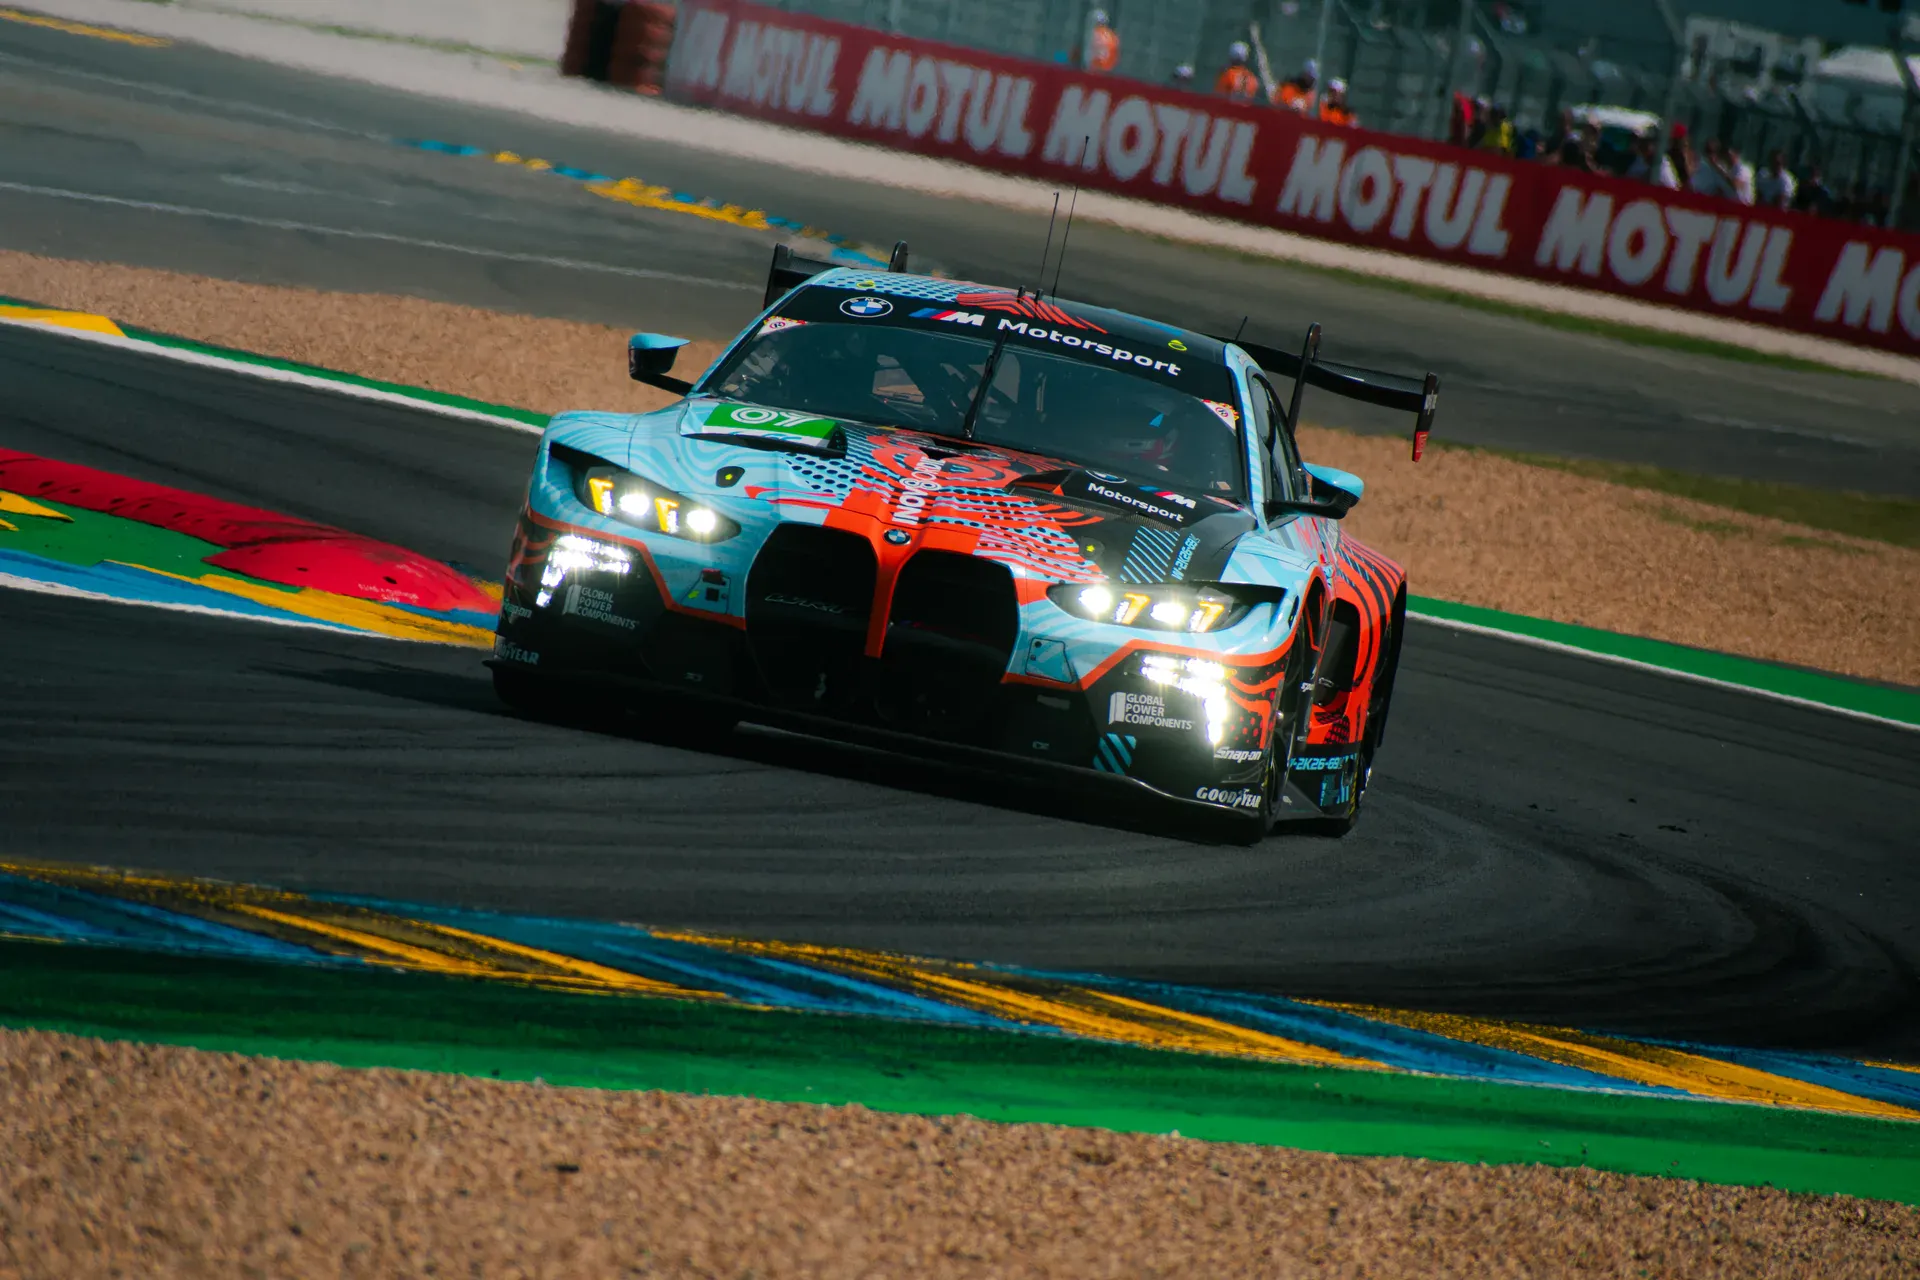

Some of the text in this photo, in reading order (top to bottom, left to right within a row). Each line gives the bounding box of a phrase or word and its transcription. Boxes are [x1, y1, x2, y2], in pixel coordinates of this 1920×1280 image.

[847, 45, 1036, 159] MOTUL
[1042, 83, 1257, 204] MOTUL
[1277, 132, 1514, 257] MOTUL
[1536, 186, 1794, 312] MOTUL
[998, 318, 1181, 376] Motorsport
[1088, 482, 1184, 522] Motorsport
[580, 596, 612, 612] POWER
[581, 587, 614, 603] GLOBAL
[576, 606, 636, 630] COMPONENTS
[1126, 693, 1165, 706] GLOBAL
[1126, 703, 1165, 717] POWER
[1125, 713, 1192, 730] COMPONENTS
[1213, 746, 1262, 763] Snap-on
[1196, 786, 1262, 808] GOODYEAR
